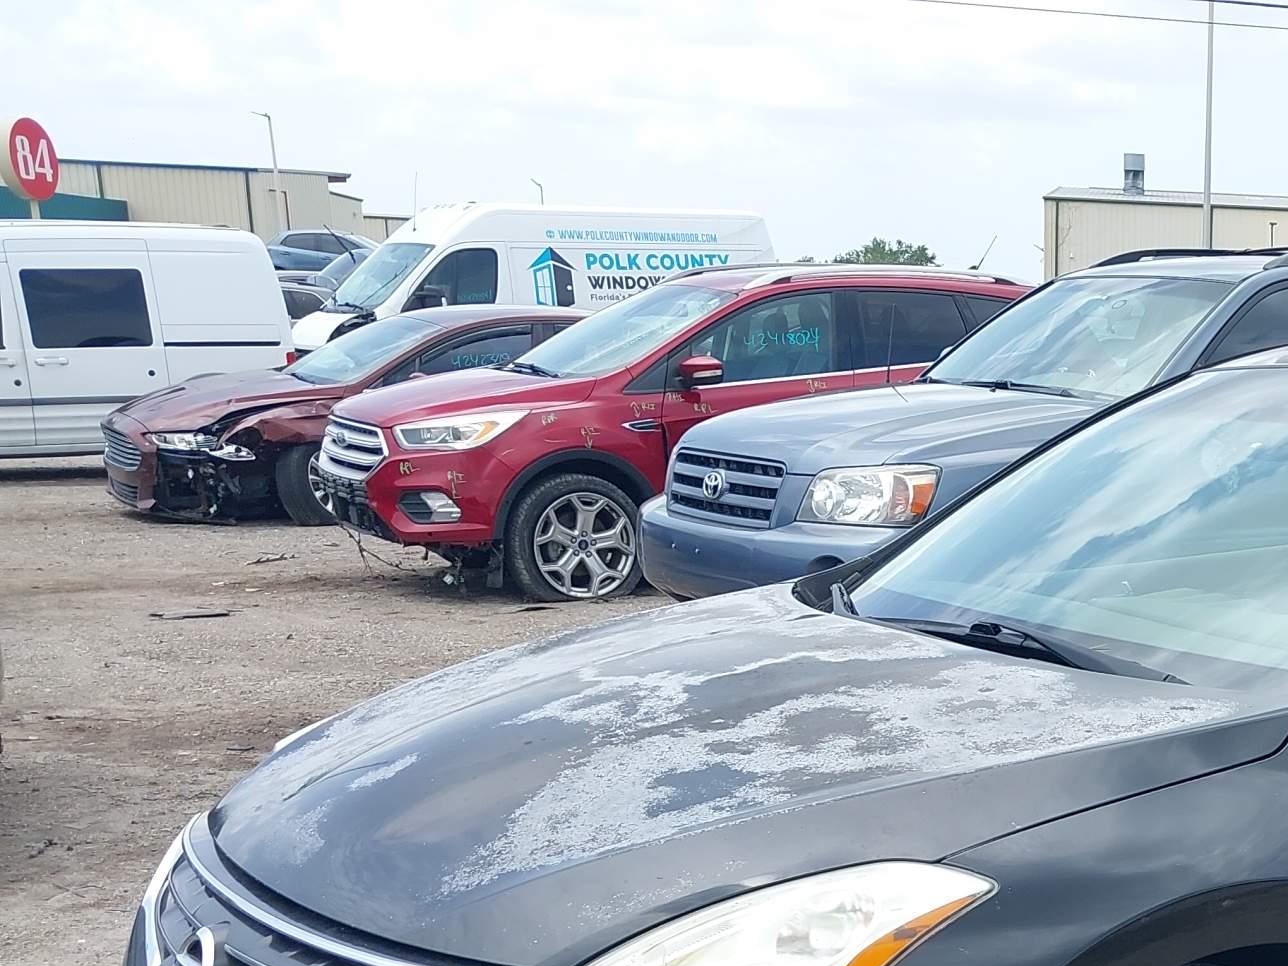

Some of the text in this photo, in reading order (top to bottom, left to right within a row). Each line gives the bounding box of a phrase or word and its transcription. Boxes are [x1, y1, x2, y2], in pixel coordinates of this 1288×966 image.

[15, 135, 53, 182] 84
[585, 253, 730, 271] POLK COUNTY
[590, 293, 626, 301] Florida's
